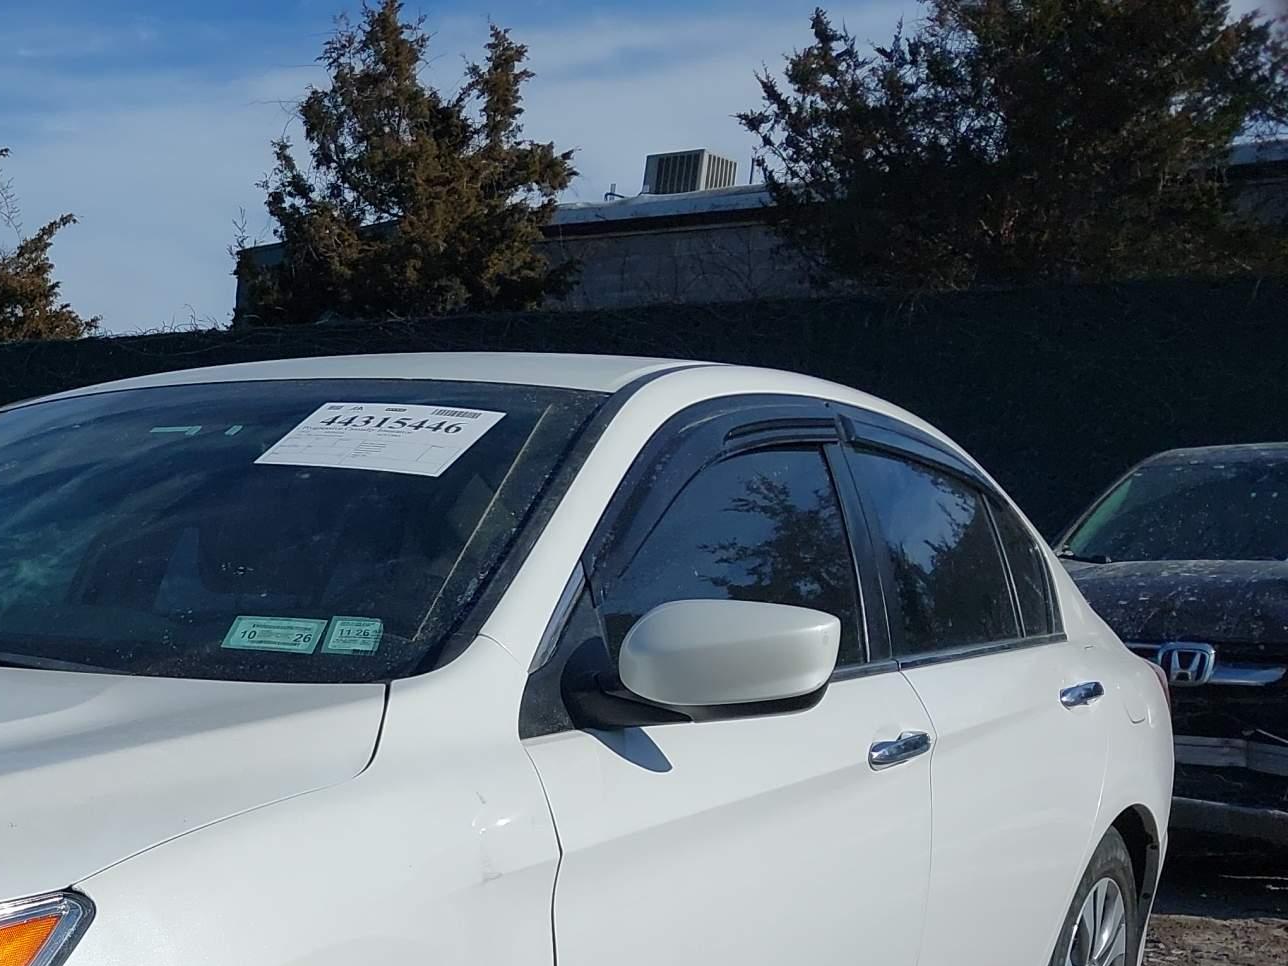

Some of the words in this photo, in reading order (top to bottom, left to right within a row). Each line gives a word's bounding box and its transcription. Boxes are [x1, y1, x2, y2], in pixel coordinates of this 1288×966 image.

[319, 414, 469, 434] 44315446
[240, 630, 257, 640] 10
[293, 633, 312, 643] 26
[355, 629, 370, 637] 26
